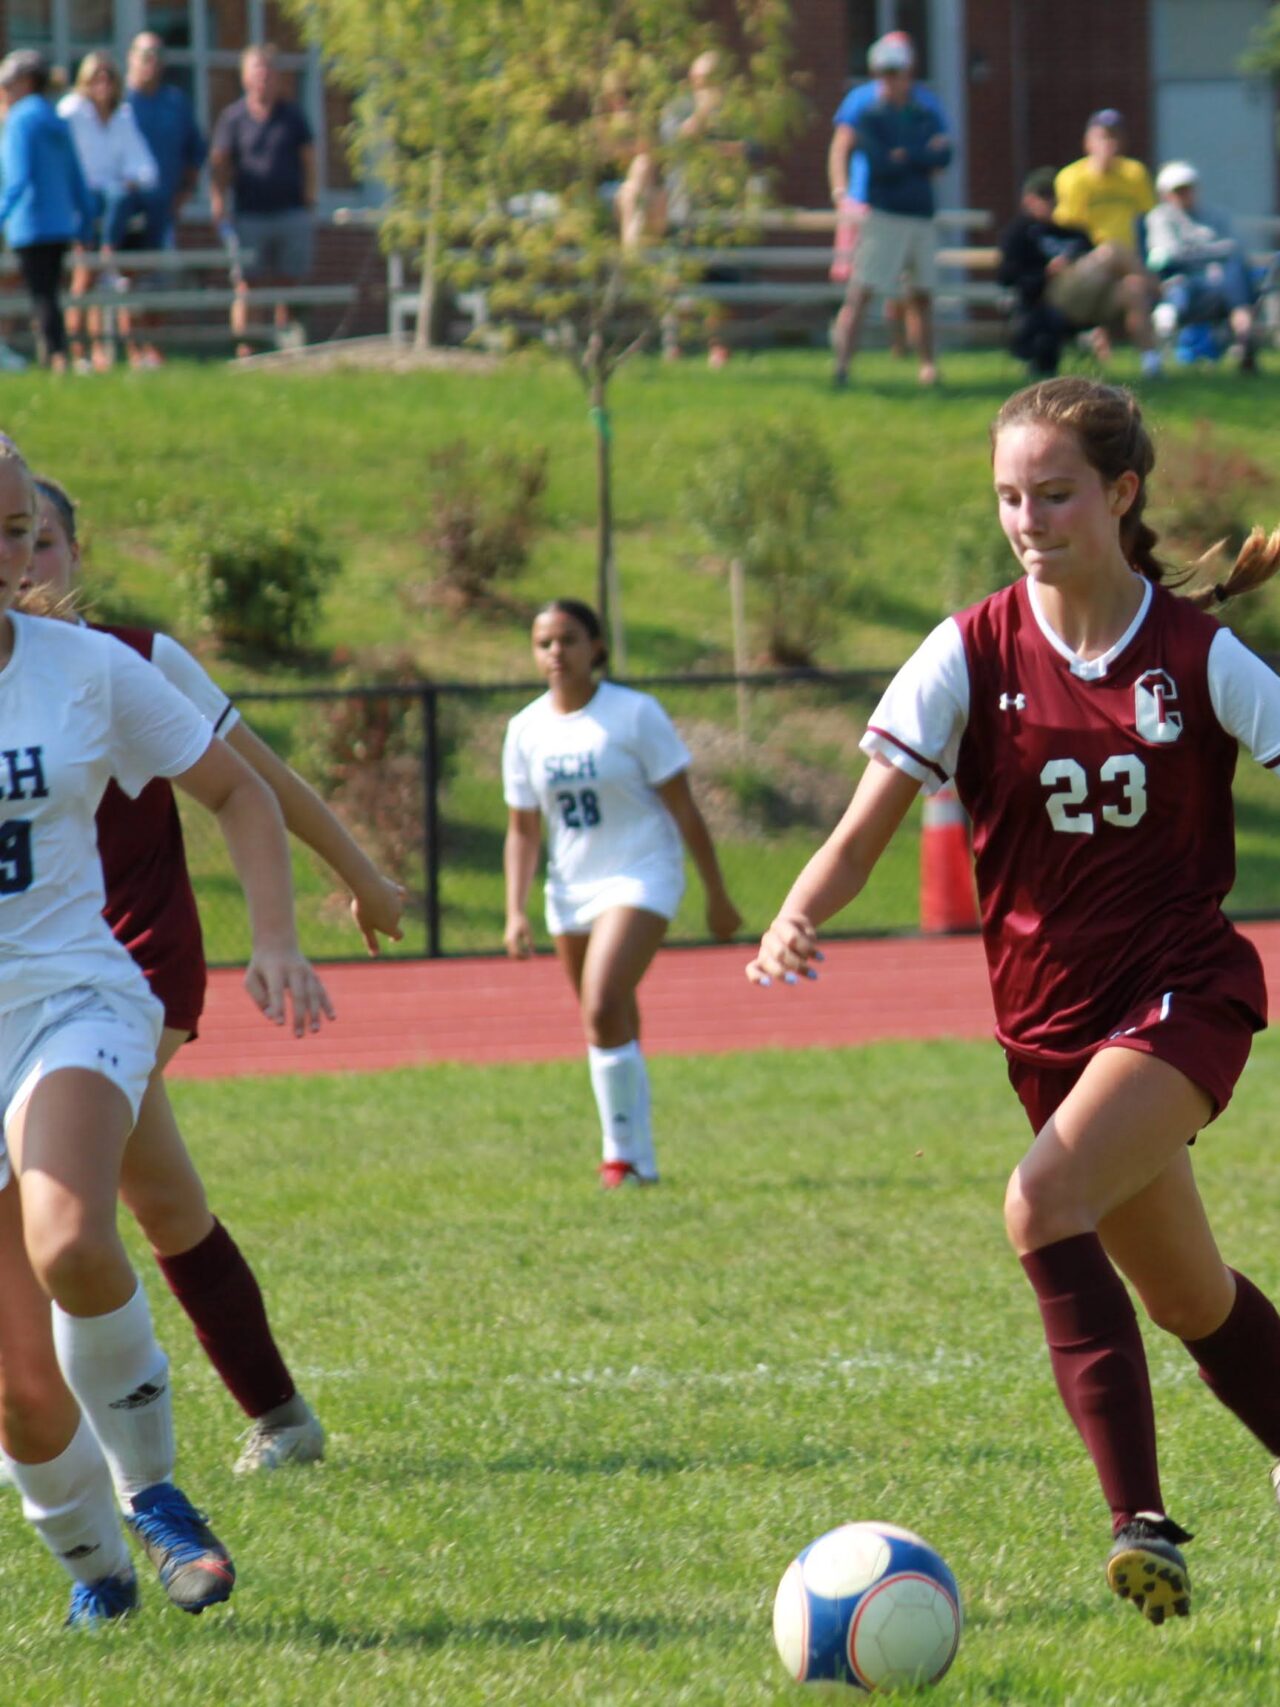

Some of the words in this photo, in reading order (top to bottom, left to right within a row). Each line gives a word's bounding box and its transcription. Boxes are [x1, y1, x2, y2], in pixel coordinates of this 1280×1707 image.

[544, 750, 597, 784] SCH
[556, 788, 602, 828] 28
[1040, 754, 1147, 834] 23
